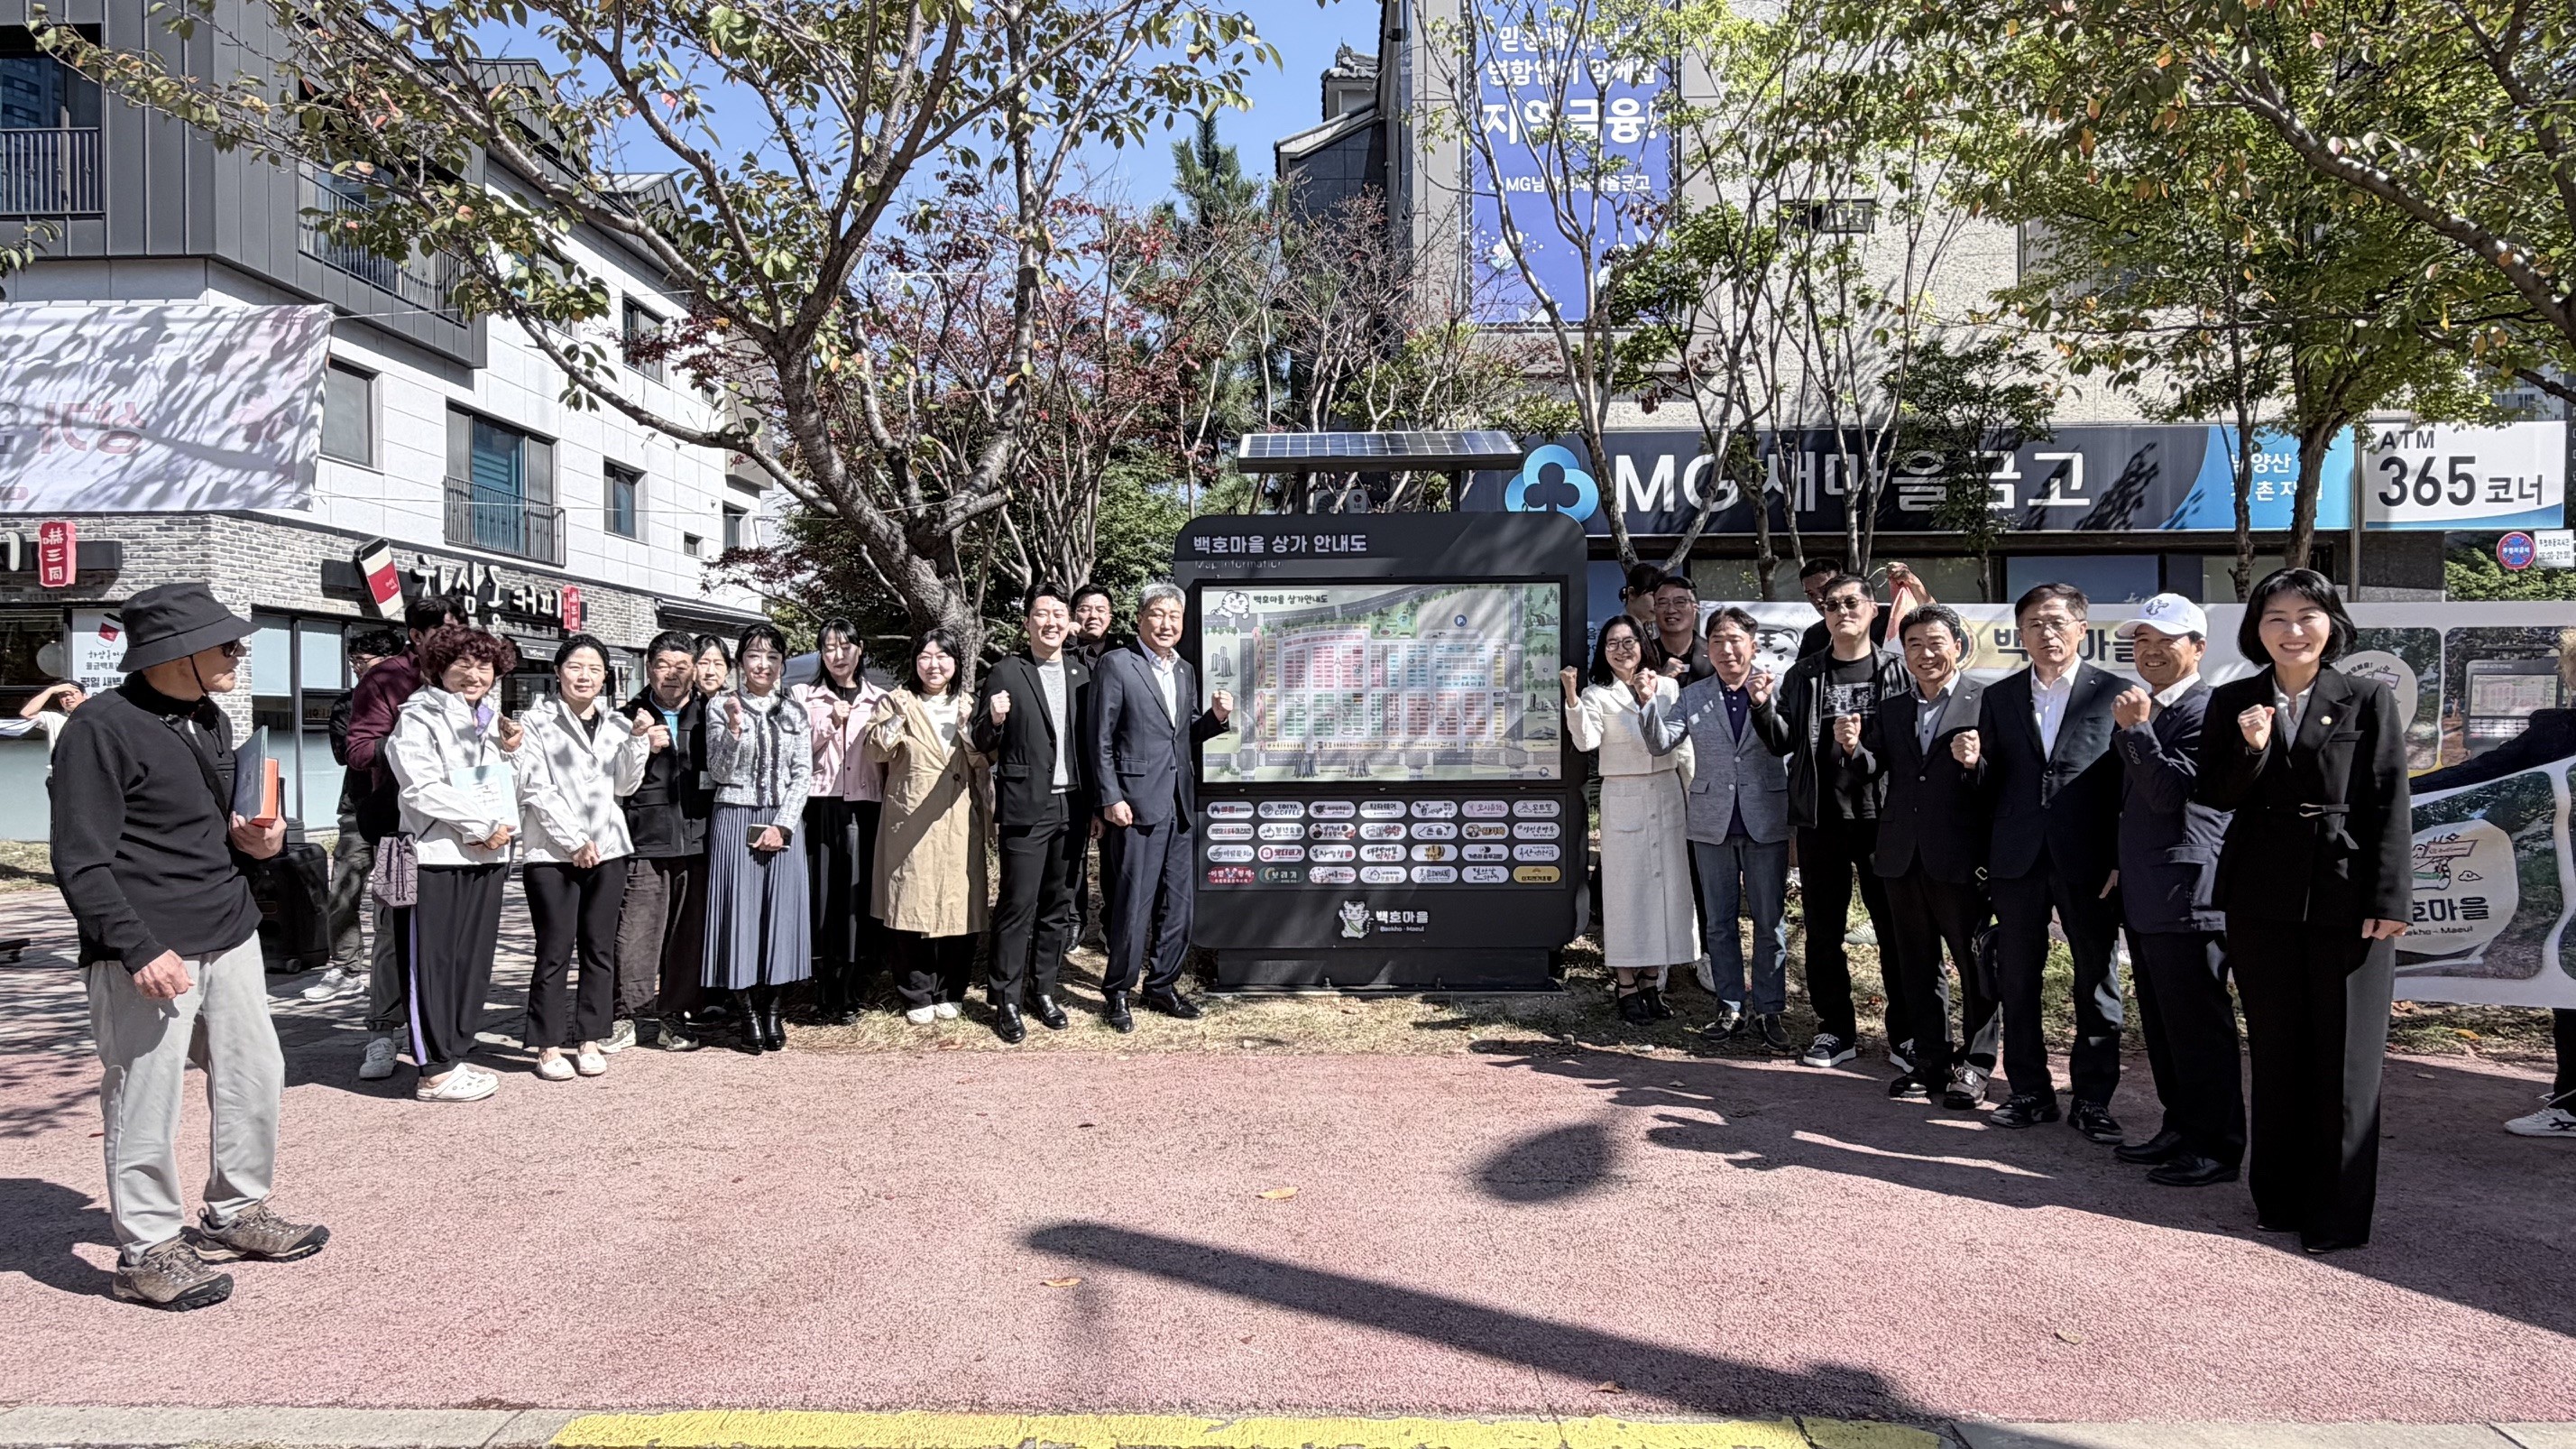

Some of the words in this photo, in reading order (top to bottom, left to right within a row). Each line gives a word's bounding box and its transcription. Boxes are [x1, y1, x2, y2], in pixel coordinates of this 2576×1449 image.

[2379, 430, 2434, 450] ATM
[2231, 480, 2276, 502] 촌
[2378, 457, 2478, 507] 365
[2485, 474, 2544, 506] 코너
[1193, 535, 1265, 554] 백호마을
[1271, 535, 1308, 553] 상가
[1313, 534, 1367, 553] 안내도
[1253, 595, 1284, 605] 백호마을
[1375, 910, 1429, 924] 백호마을
[2412, 896, 2489, 922] 호마을
